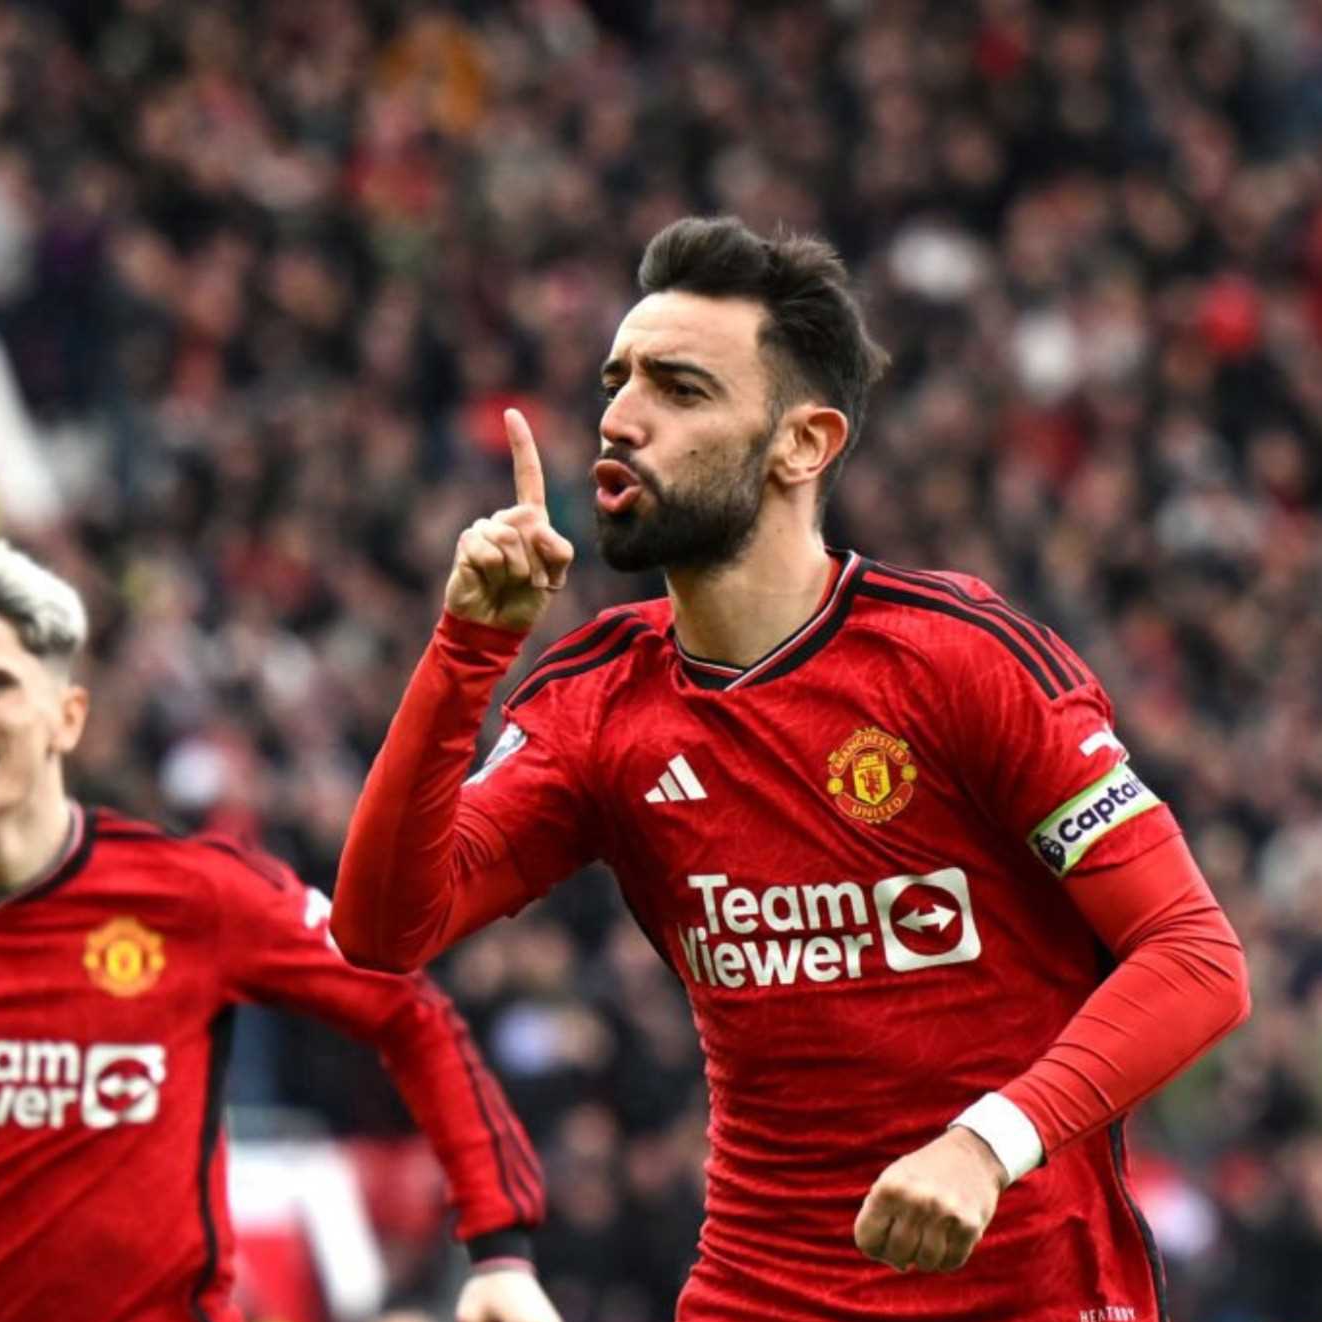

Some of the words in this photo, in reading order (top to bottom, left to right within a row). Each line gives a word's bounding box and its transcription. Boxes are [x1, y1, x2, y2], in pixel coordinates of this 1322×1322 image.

[852, 797, 903, 817] UNITED
[687, 874, 869, 934] Team
[679, 924, 874, 988] Viewer
